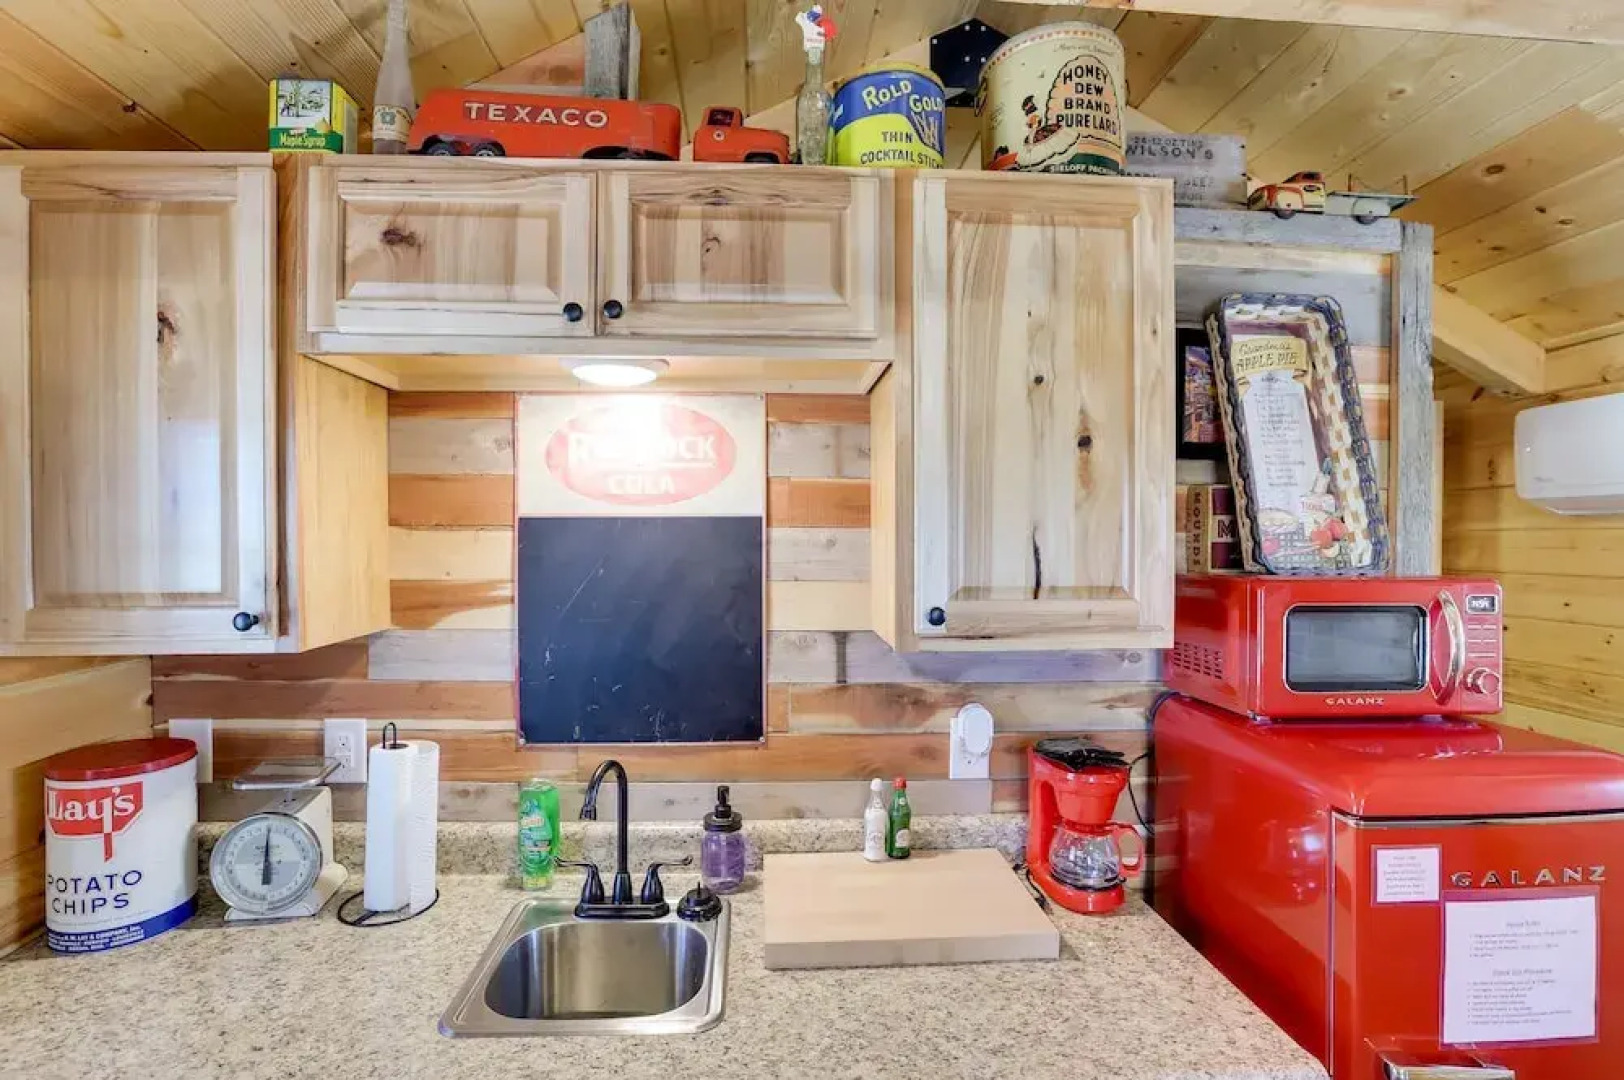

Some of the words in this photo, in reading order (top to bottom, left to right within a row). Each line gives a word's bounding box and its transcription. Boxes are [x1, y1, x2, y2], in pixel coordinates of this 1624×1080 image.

[1063, 65, 1108, 85] HONEY
[862, 80, 912, 110] ROLD
[908, 94, 944, 113] GOLD
[1075, 82, 1104, 96] DEW
[465, 102, 609, 128] TEXACO
[1064, 98, 1111, 115] BRAND
[1056, 115, 1090, 128] PURE
[1092, 115, 1117, 136] LARD
[881, 131, 914, 144] THIN
[860, 148, 915, 165] COCKTAIL
[1235, 353, 1274, 373] APPLE
[1277, 351, 1299, 367] PIE
[607, 474, 676, 495] COLA
[1324, 696, 1385, 706] GALANZ
[48, 785, 136, 856] Lay's
[48, 870, 143, 894] POTATO
[1450, 865, 1606, 888] GALANZ
[52, 892, 130, 915] CHIPS
